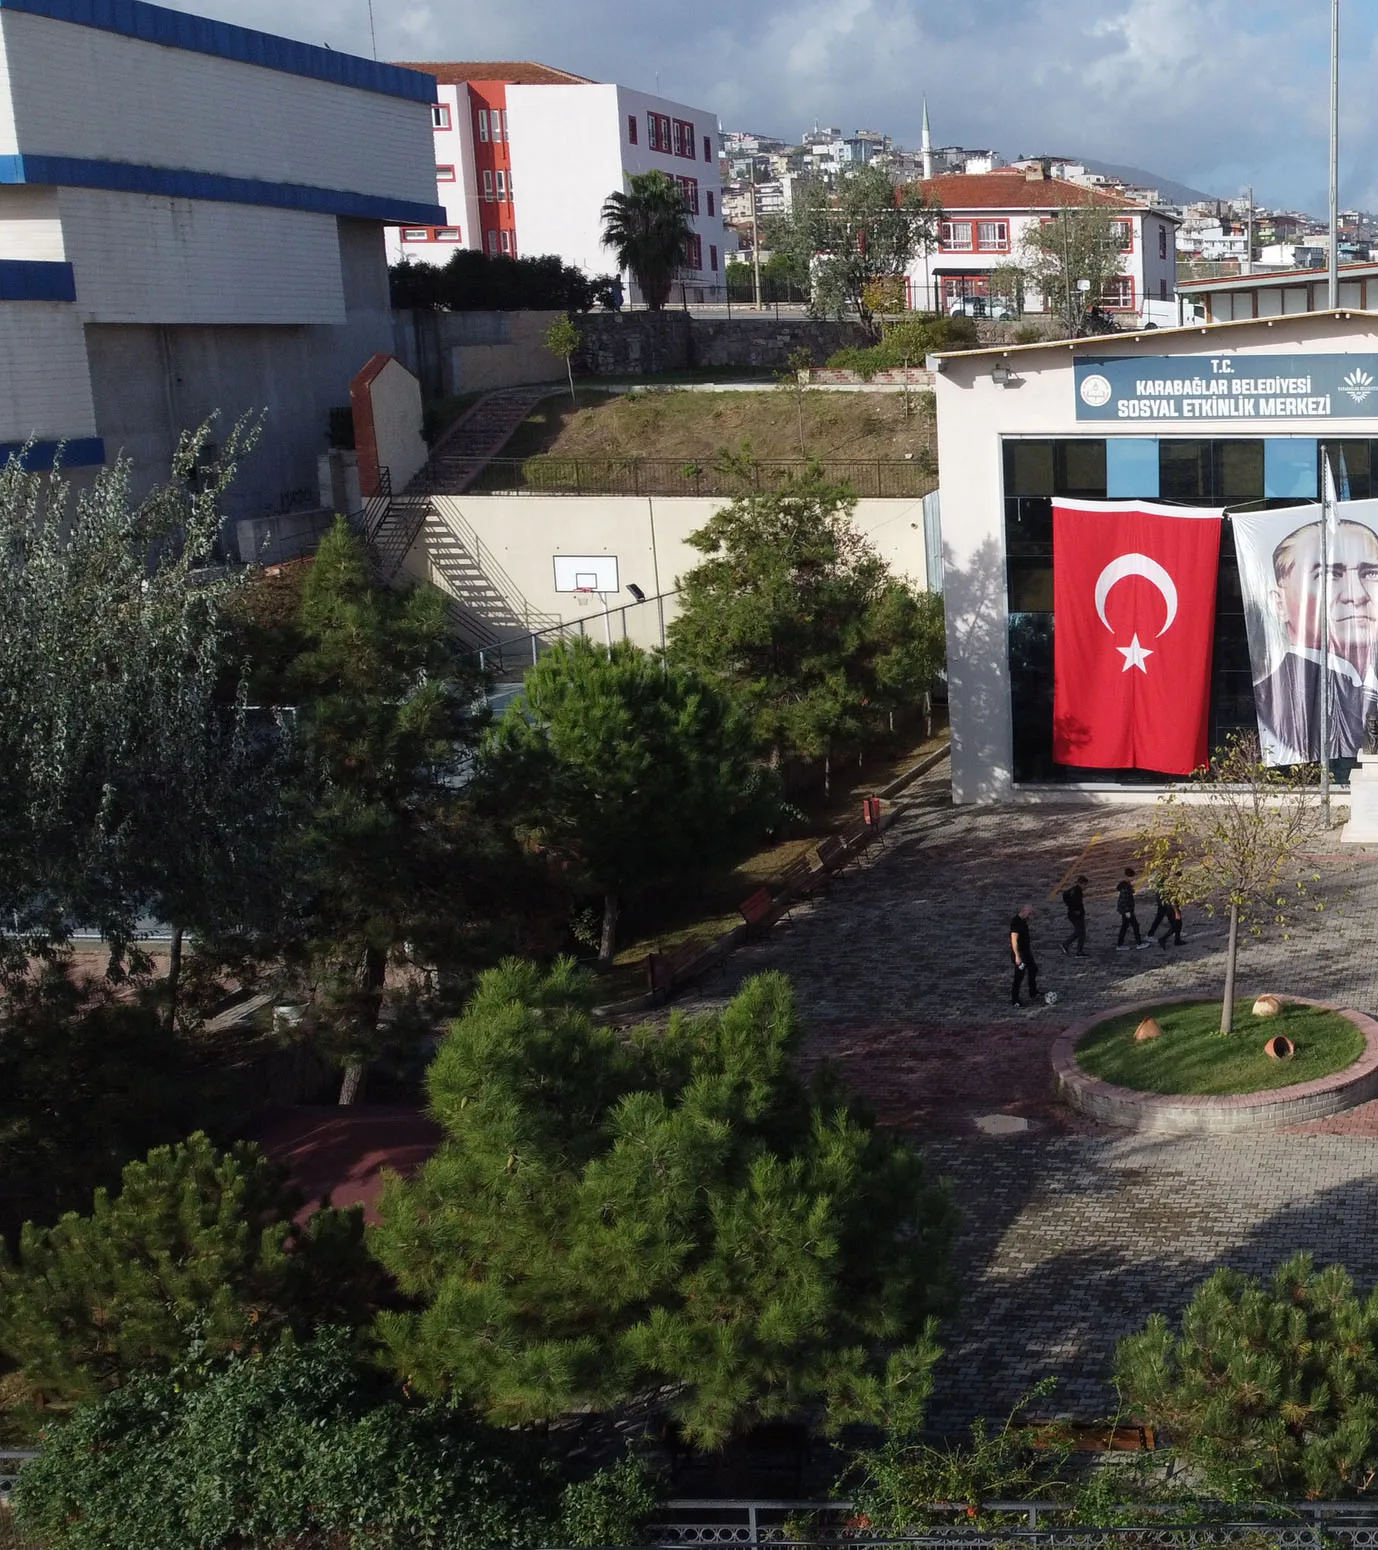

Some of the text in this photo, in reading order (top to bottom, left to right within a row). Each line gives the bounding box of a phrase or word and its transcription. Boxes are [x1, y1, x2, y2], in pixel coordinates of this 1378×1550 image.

[1211, 359, 1235, 373] T.C.
[1136, 375, 1311, 395] KARABAĞLAR BELEDİYESİ
[1117, 394, 1331, 417] SOSYAL ETKİNLİK MERKEZİ
